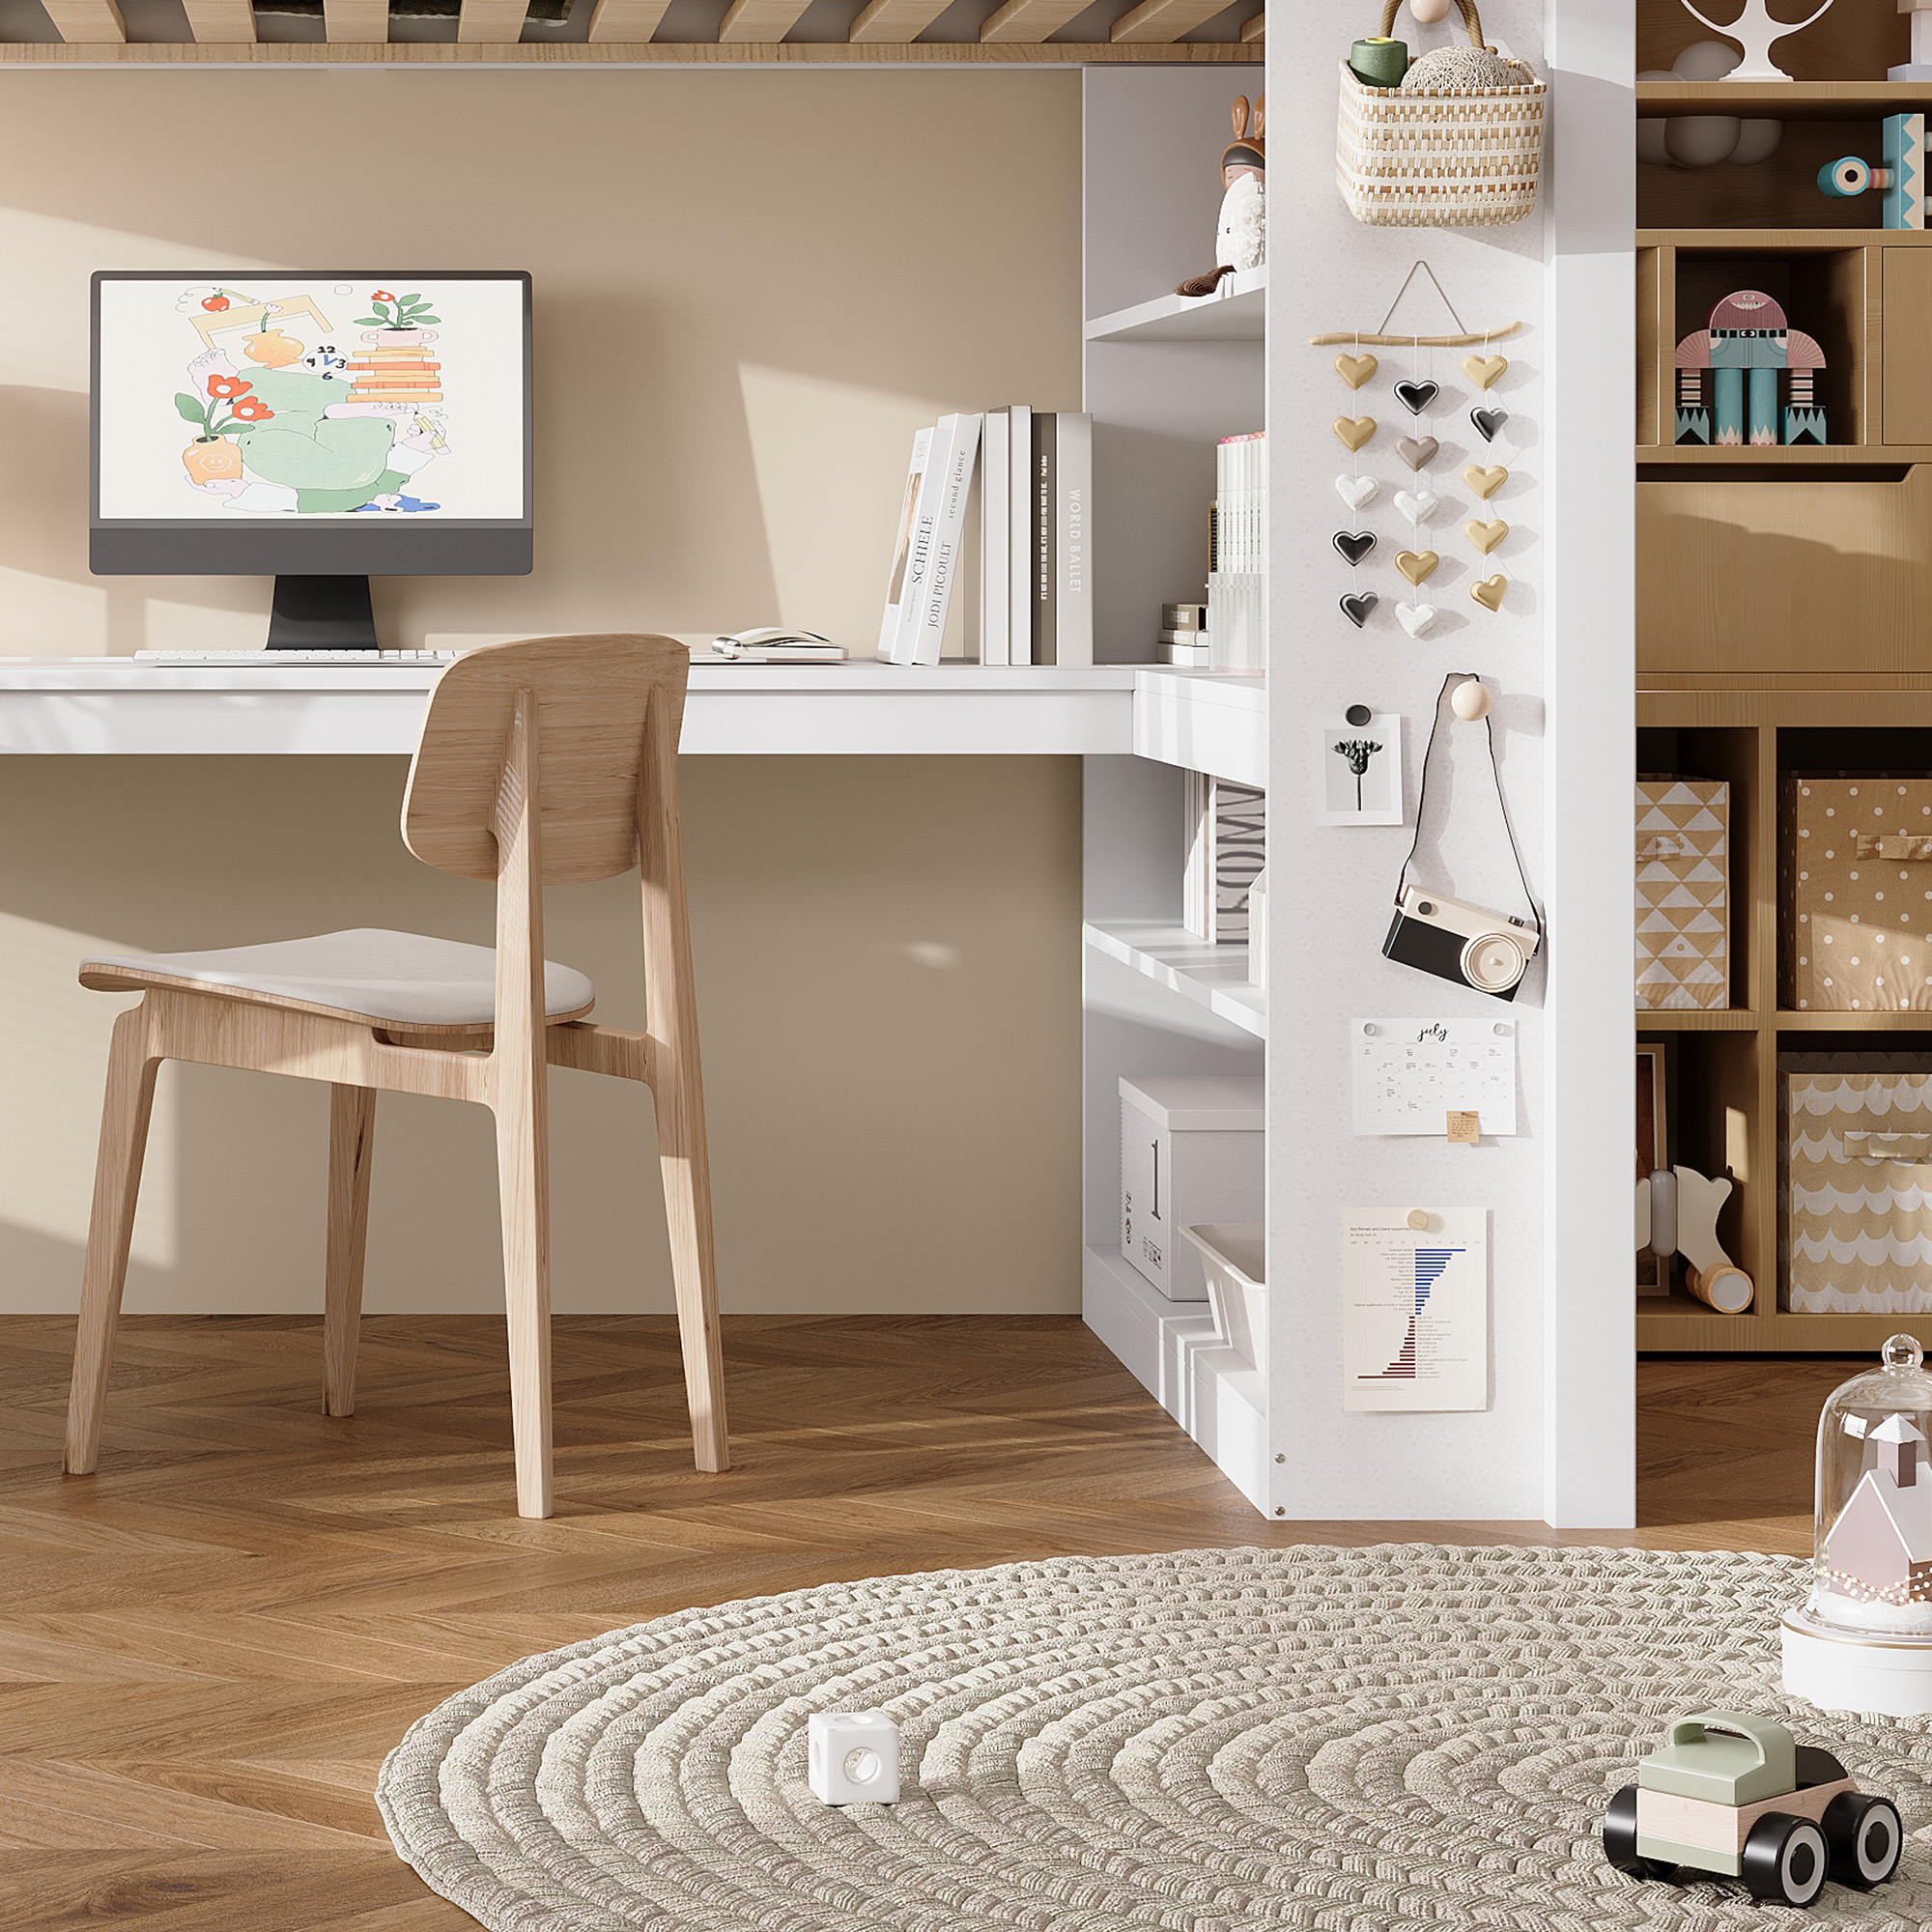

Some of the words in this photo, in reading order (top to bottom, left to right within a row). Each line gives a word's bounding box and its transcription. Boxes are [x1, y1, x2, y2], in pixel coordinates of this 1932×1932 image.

[306, 357, 315, 367] 9
[322, 371, 333, 380] 6
[335, 358, 347, 369] 3
[953, 450, 966, 483] glance
[949, 485, 959, 519] second
[1069, 489, 1082, 539] WORLD
[911, 516, 933, 584] SCHIELE
[932, 541, 952, 596] PICOULT
[1069, 545, 1082, 593] BALLET
[927, 599, 942, 629] JODI
[1416, 1023, 1449, 1042] july
